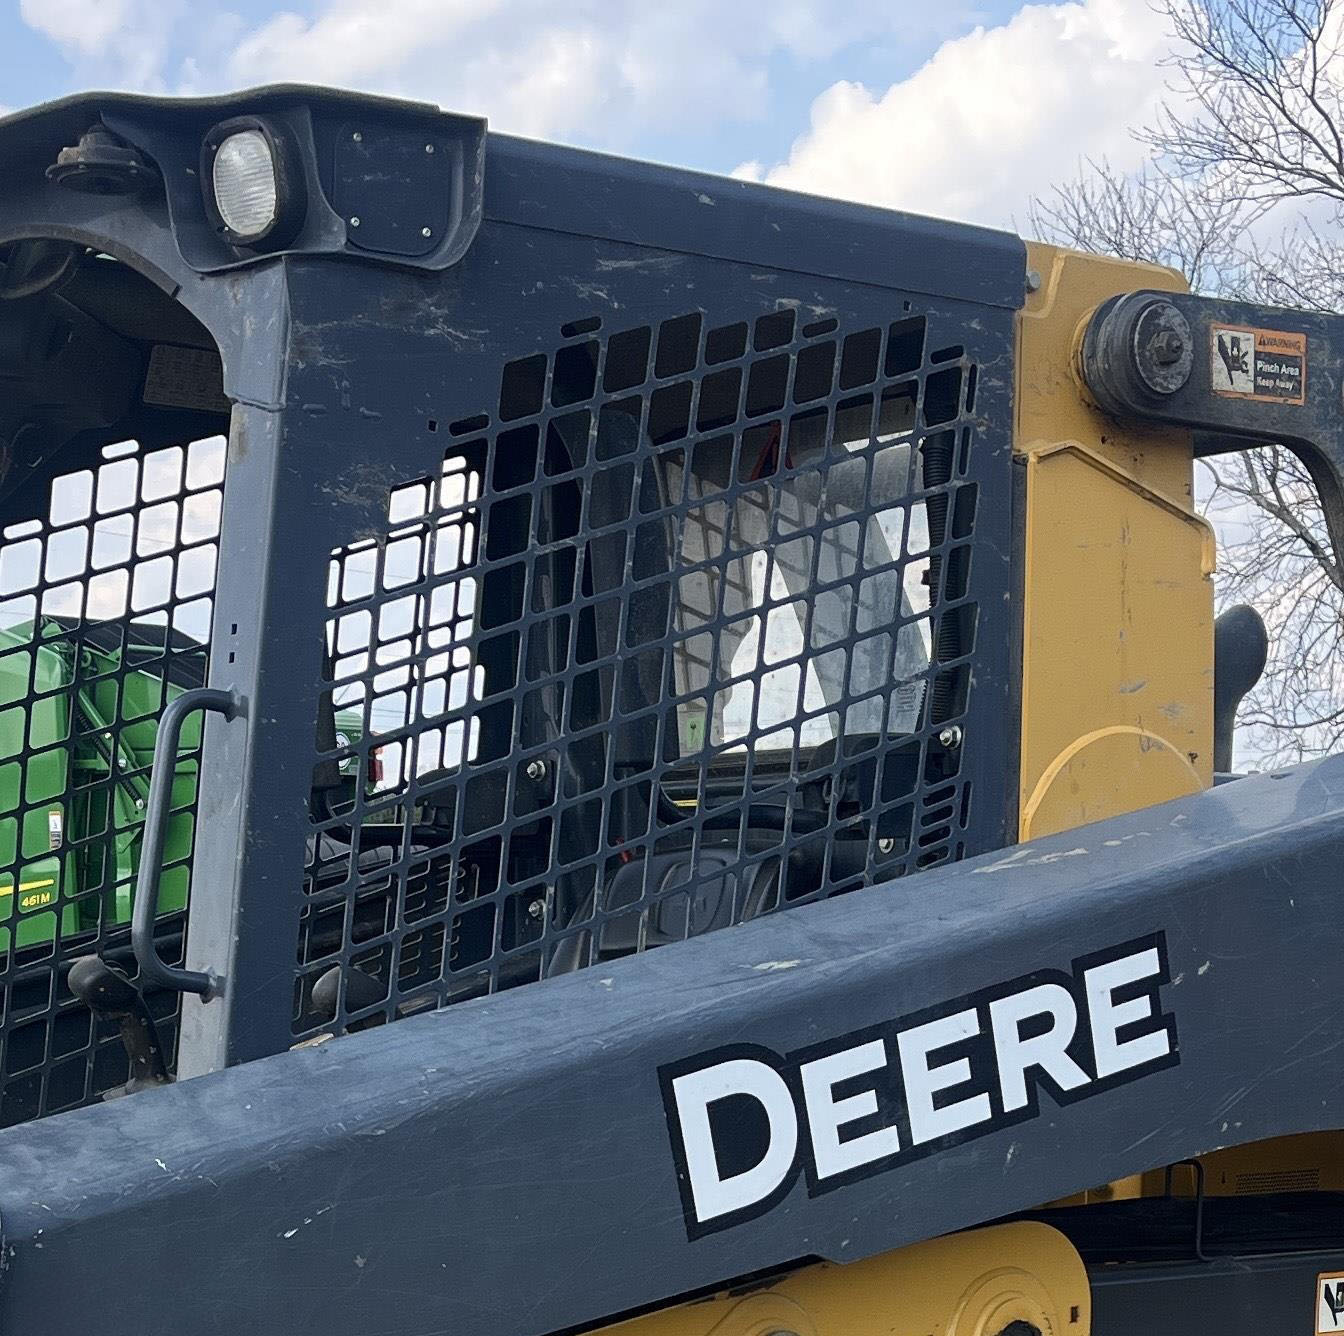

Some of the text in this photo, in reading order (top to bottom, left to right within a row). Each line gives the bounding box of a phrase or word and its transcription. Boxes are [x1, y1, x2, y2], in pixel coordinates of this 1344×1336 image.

[1265, 336, 1301, 350] WARNING
[1257, 360, 1299, 375] Pinch Area
[1257, 376, 1294, 391] Keep Away
[21, 892, 51, 907] 461M
[672, 947, 1171, 1223] DEERE
